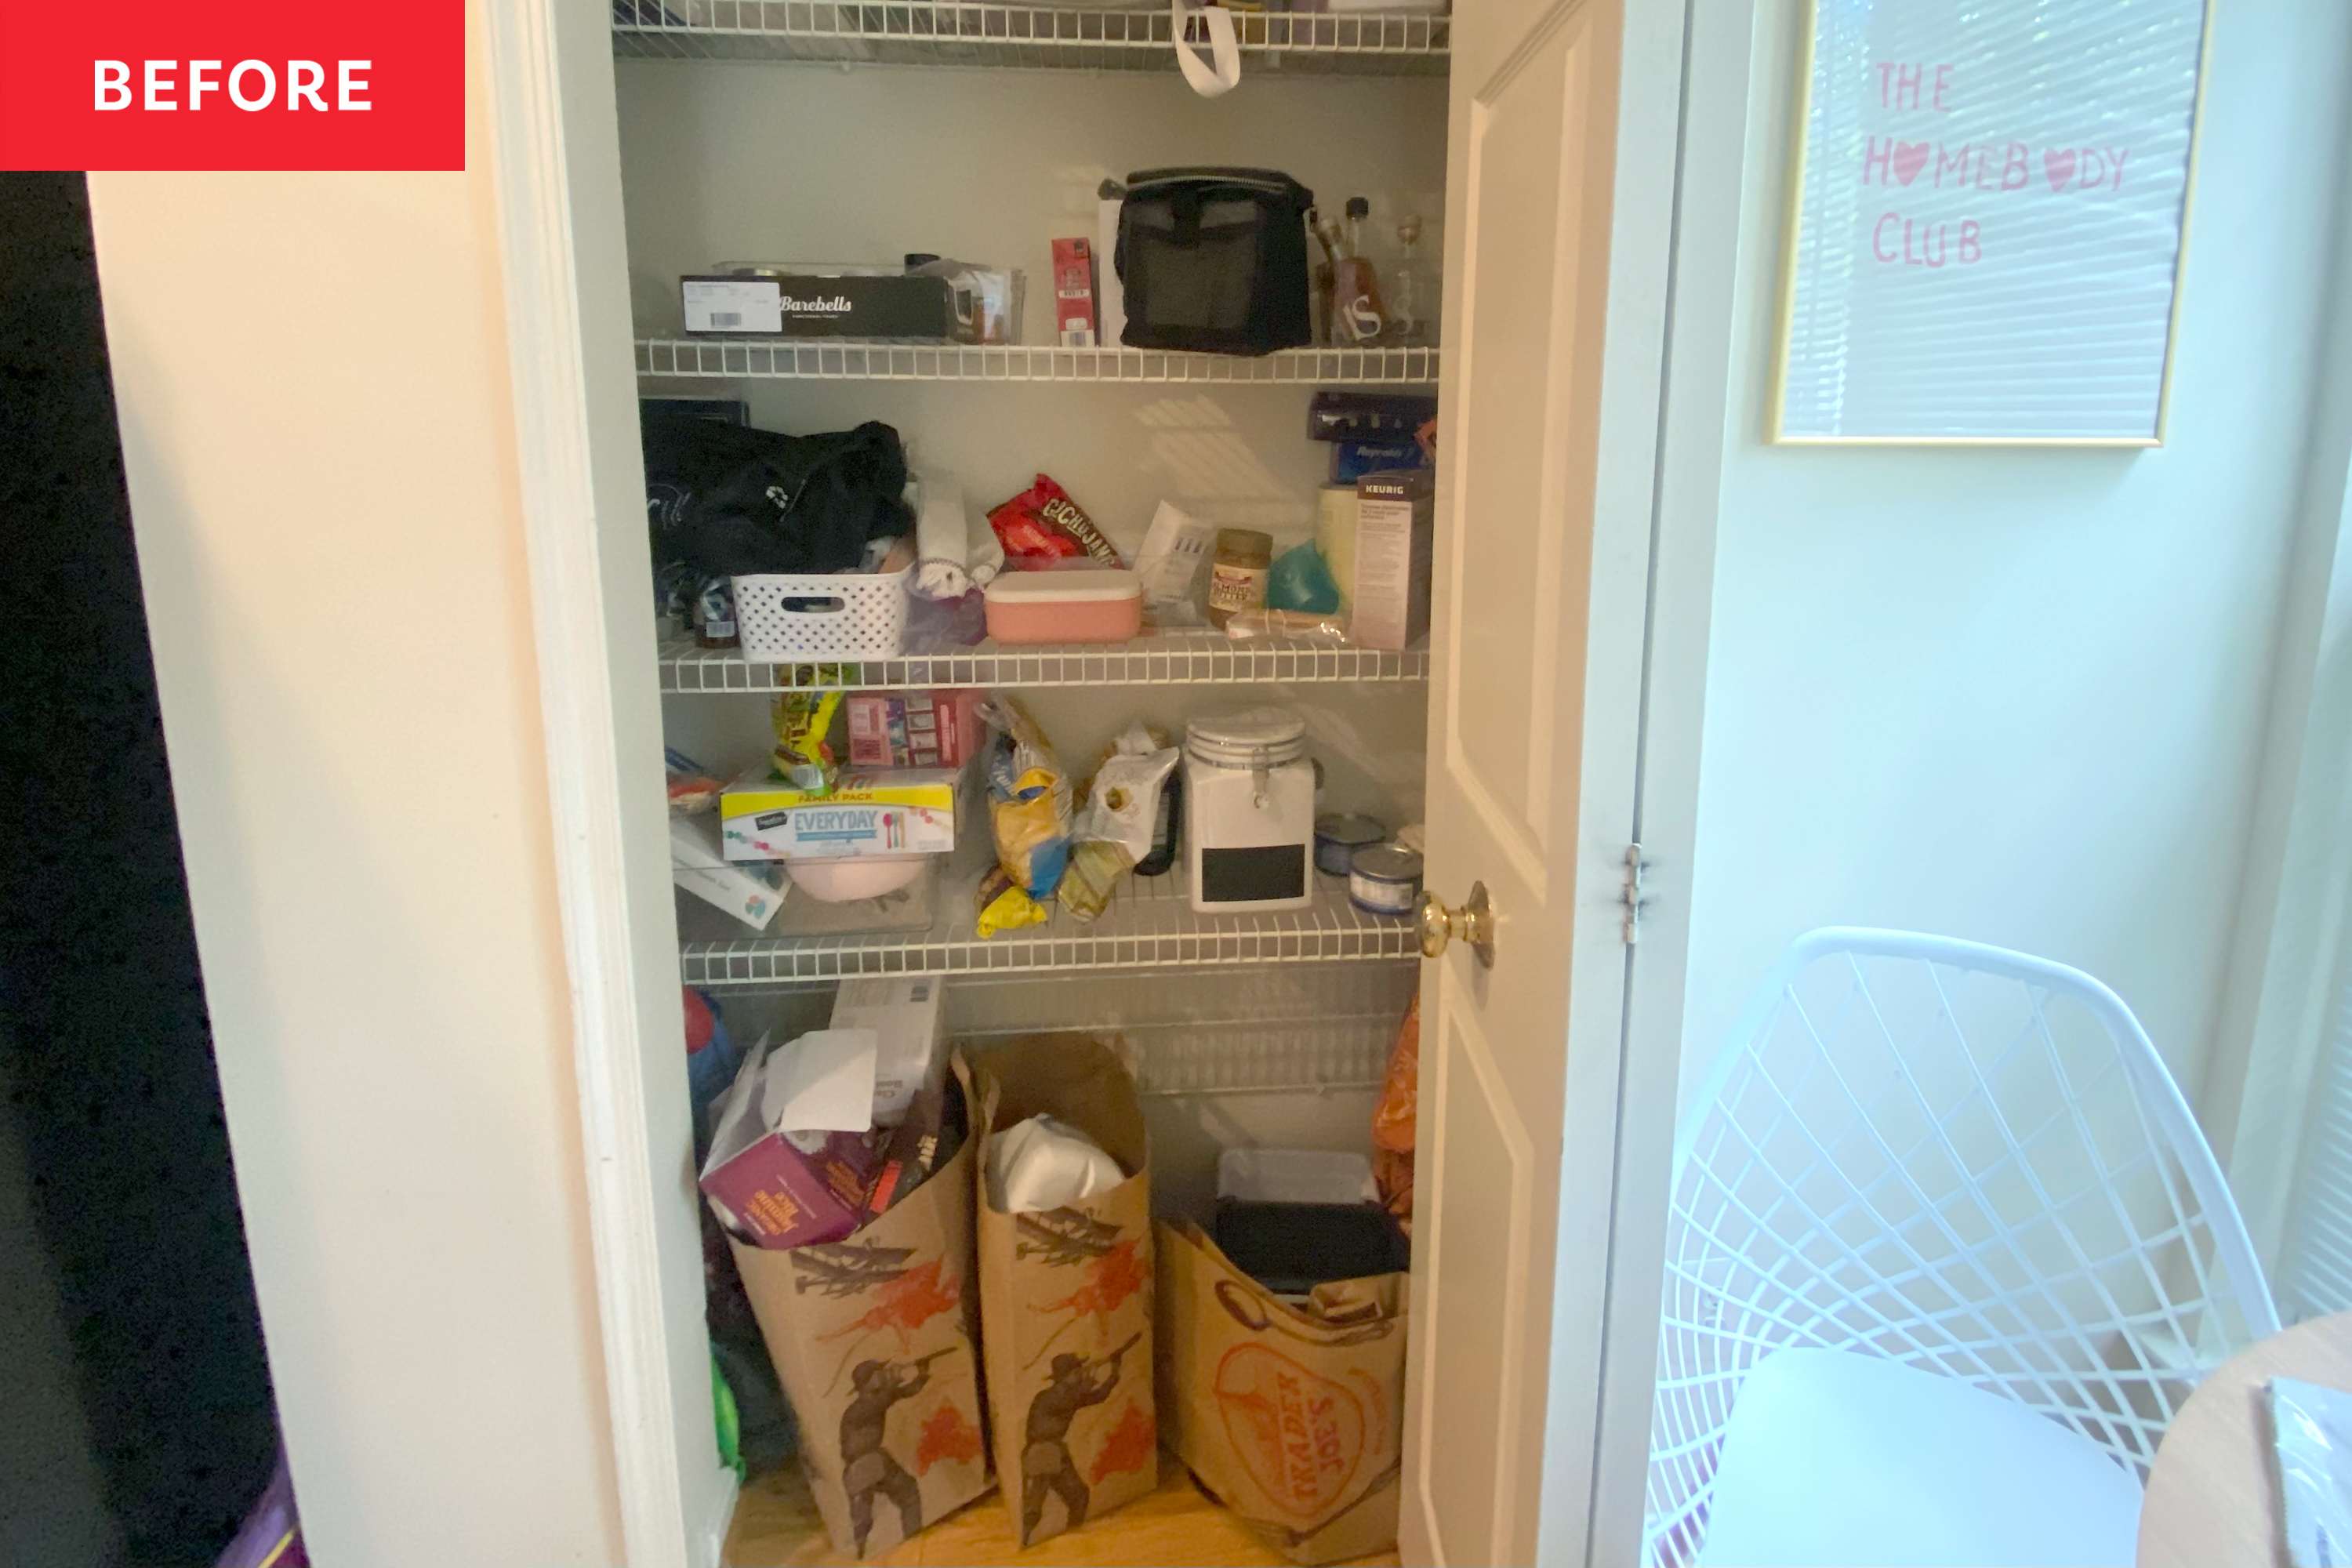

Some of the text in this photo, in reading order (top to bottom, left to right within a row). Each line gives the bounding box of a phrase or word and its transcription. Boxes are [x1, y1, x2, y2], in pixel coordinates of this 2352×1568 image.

[1877, 63, 1954, 111] THE
[1873, 212, 1983, 268] CLUB
[780, 296, 852, 312] Barebells
[1366, 485, 1403, 494] KEURIG
[798, 793, 873, 803] FAMILY PACK
[794, 811, 878, 831] EVERYDAY
